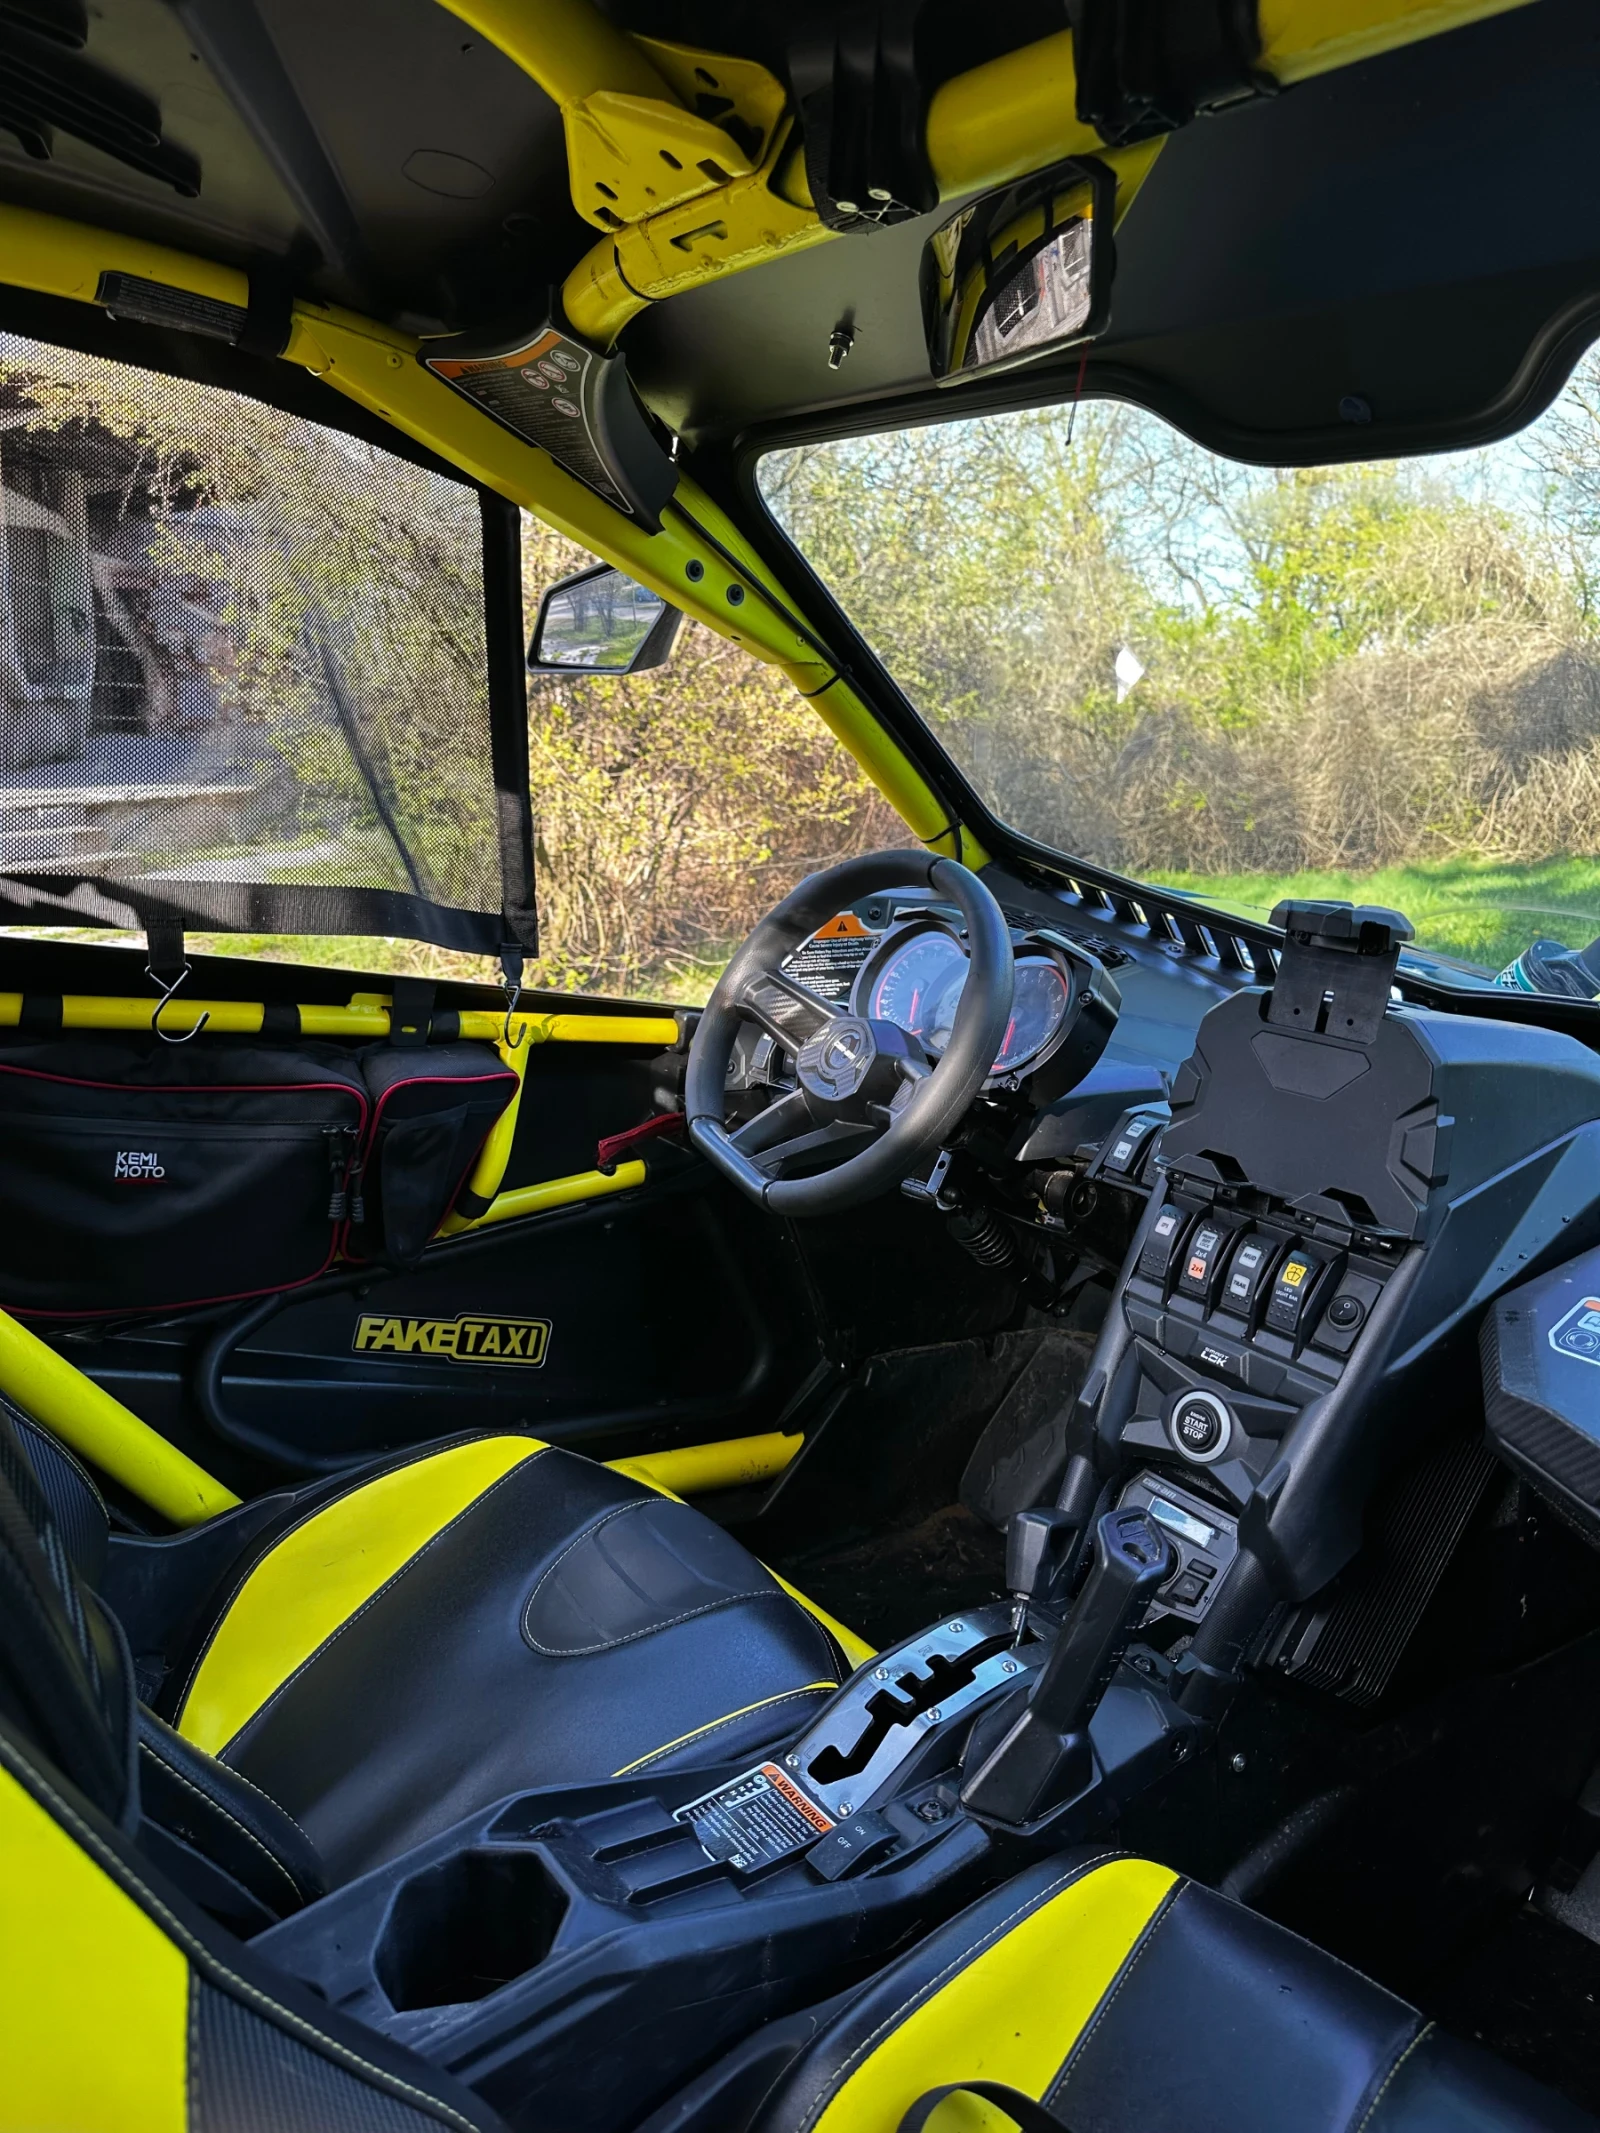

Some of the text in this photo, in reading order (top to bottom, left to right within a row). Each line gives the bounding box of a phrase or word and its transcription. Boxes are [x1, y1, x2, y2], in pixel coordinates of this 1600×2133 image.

[116, 1151, 158, 1166] KEMI
[114, 1164, 165, 1178] MOTO
[1194, 1250, 1208, 1259] 4x4
[1243, 1252, 1258, 1261] MUD
[1191, 1263, 1204, 1274] 2x4
[1233, 1279, 1247, 1290] TRAIL
[1275, 1289, 1298, 1302] LIGHT BAR
[1190, 1411, 1206, 1422] ENGINE
[1184, 1415, 1209, 1432] START
[1182, 1426, 1204, 1441] STOP
[1142, 1477, 1177, 1499] can-am
[777, 1780, 827, 1829] WARNING
[855, 1825, 867, 1836] ON
[837, 1836, 852, 1849] OFF
